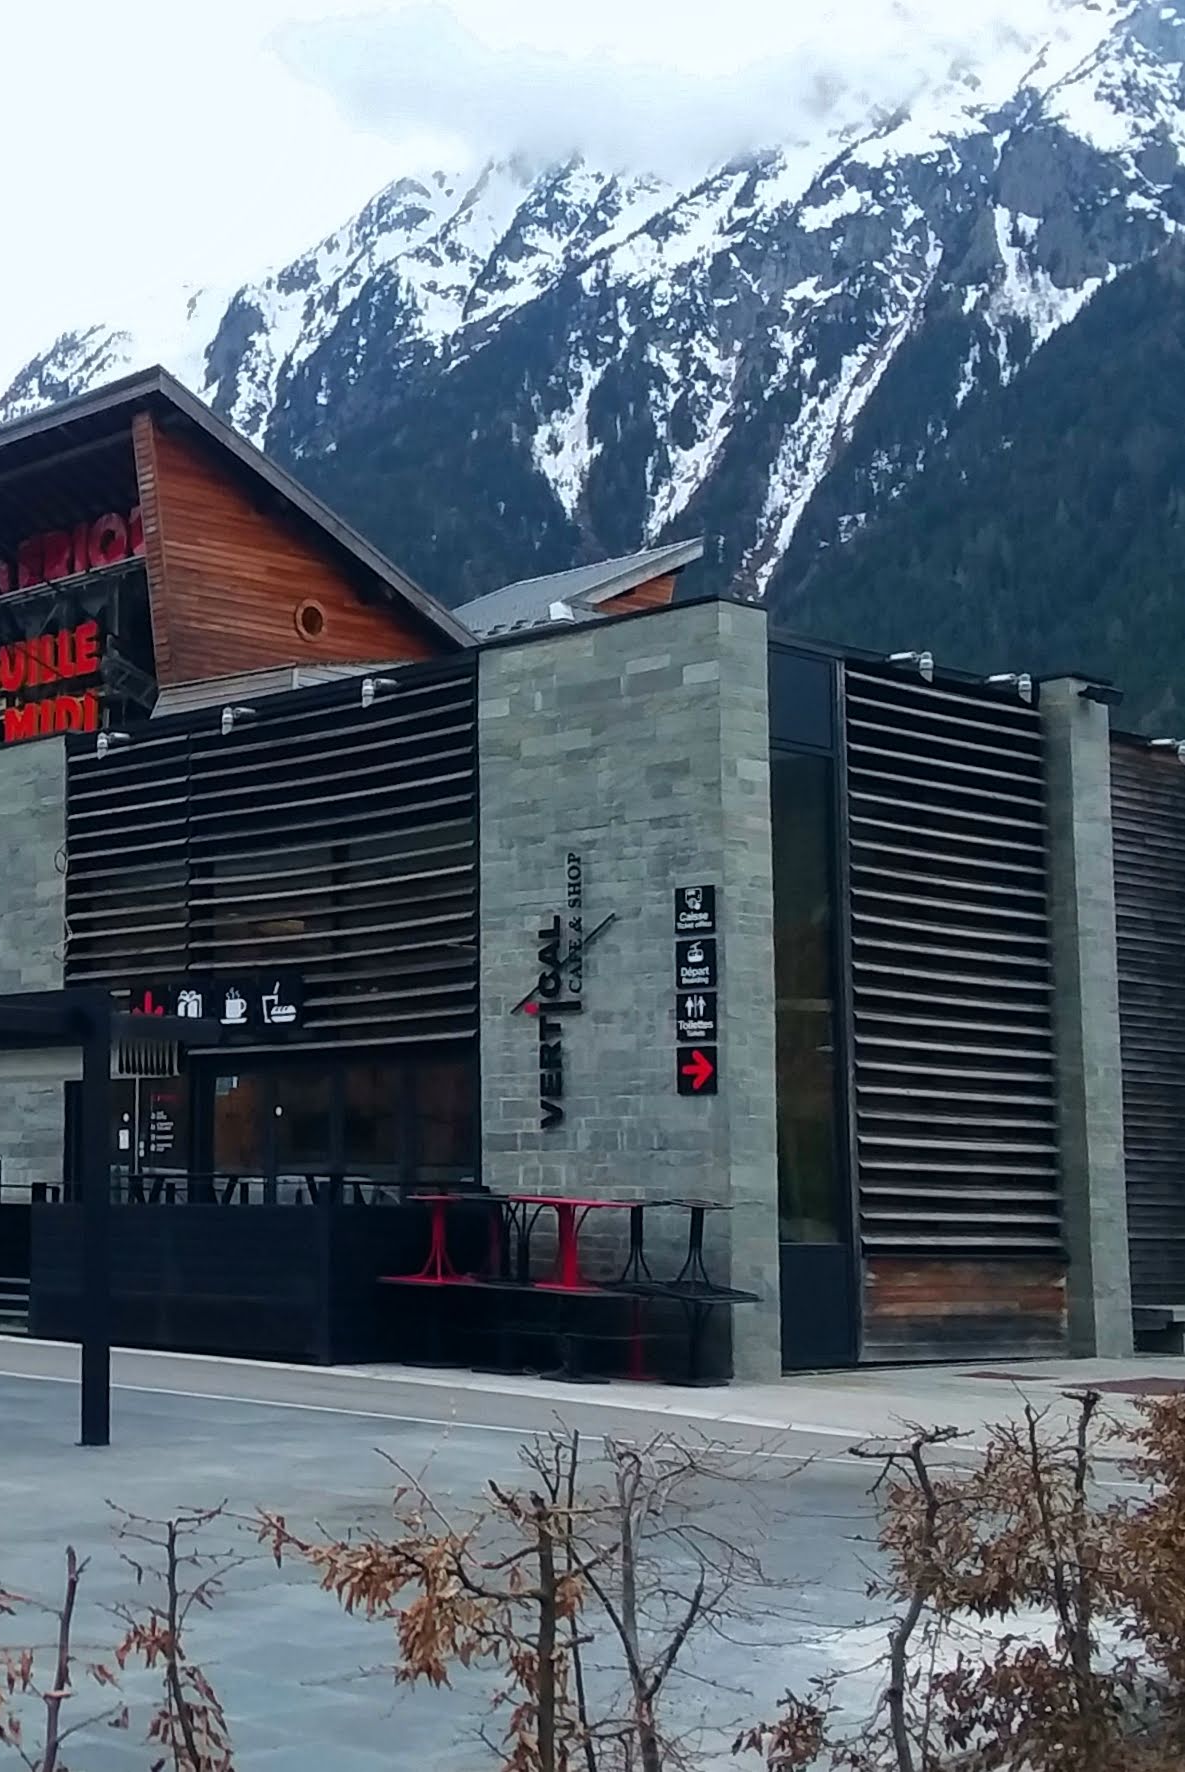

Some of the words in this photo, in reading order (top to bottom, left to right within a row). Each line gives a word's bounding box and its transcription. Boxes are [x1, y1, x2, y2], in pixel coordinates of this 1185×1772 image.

[3, 688, 98, 743] MIDI
[568, 852, 582, 909] SHOP
[679, 911, 709, 922] Caisse
[569, 917, 583, 932] &
[569, 938, 583, 994] CAFE
[680, 966, 710, 977] Départ
[678, 1020, 714, 1030] Toilettes
